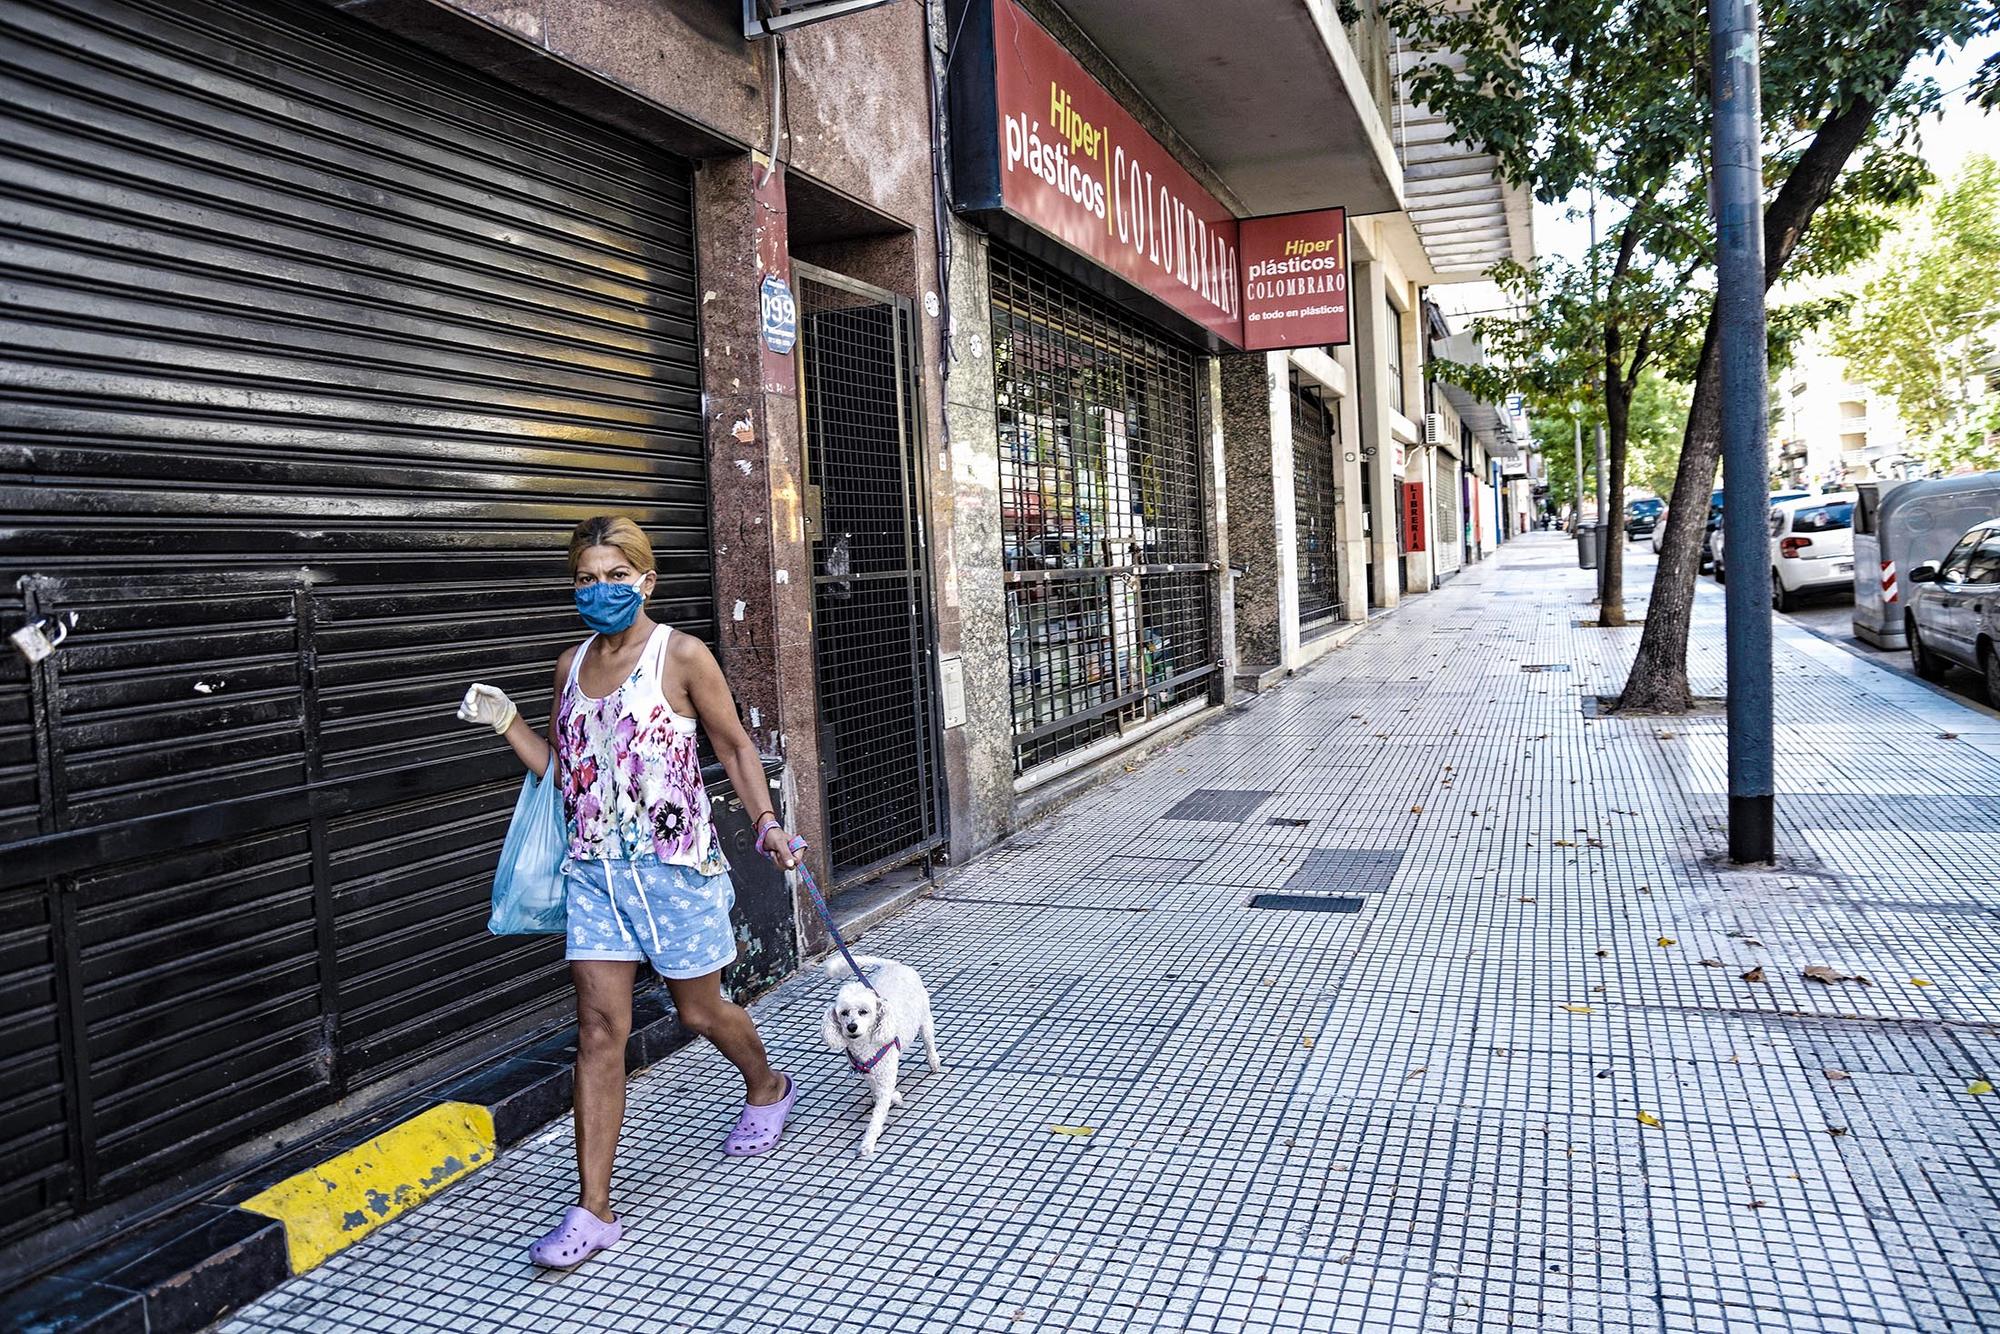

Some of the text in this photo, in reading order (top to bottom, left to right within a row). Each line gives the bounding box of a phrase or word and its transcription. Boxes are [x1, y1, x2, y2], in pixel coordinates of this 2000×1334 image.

[1051, 81, 1101, 160] Hiper
[1005, 112, 1105, 219] plásticos
[1114, 145, 1238, 320] COLOMBRARO
[1285, 240, 1334, 257] Hiper
[1249, 257, 1335, 281] plásticos
[1247, 273, 1345, 300] COLOMBRARO
[1248, 305, 1344, 321] de todo en plásticos
